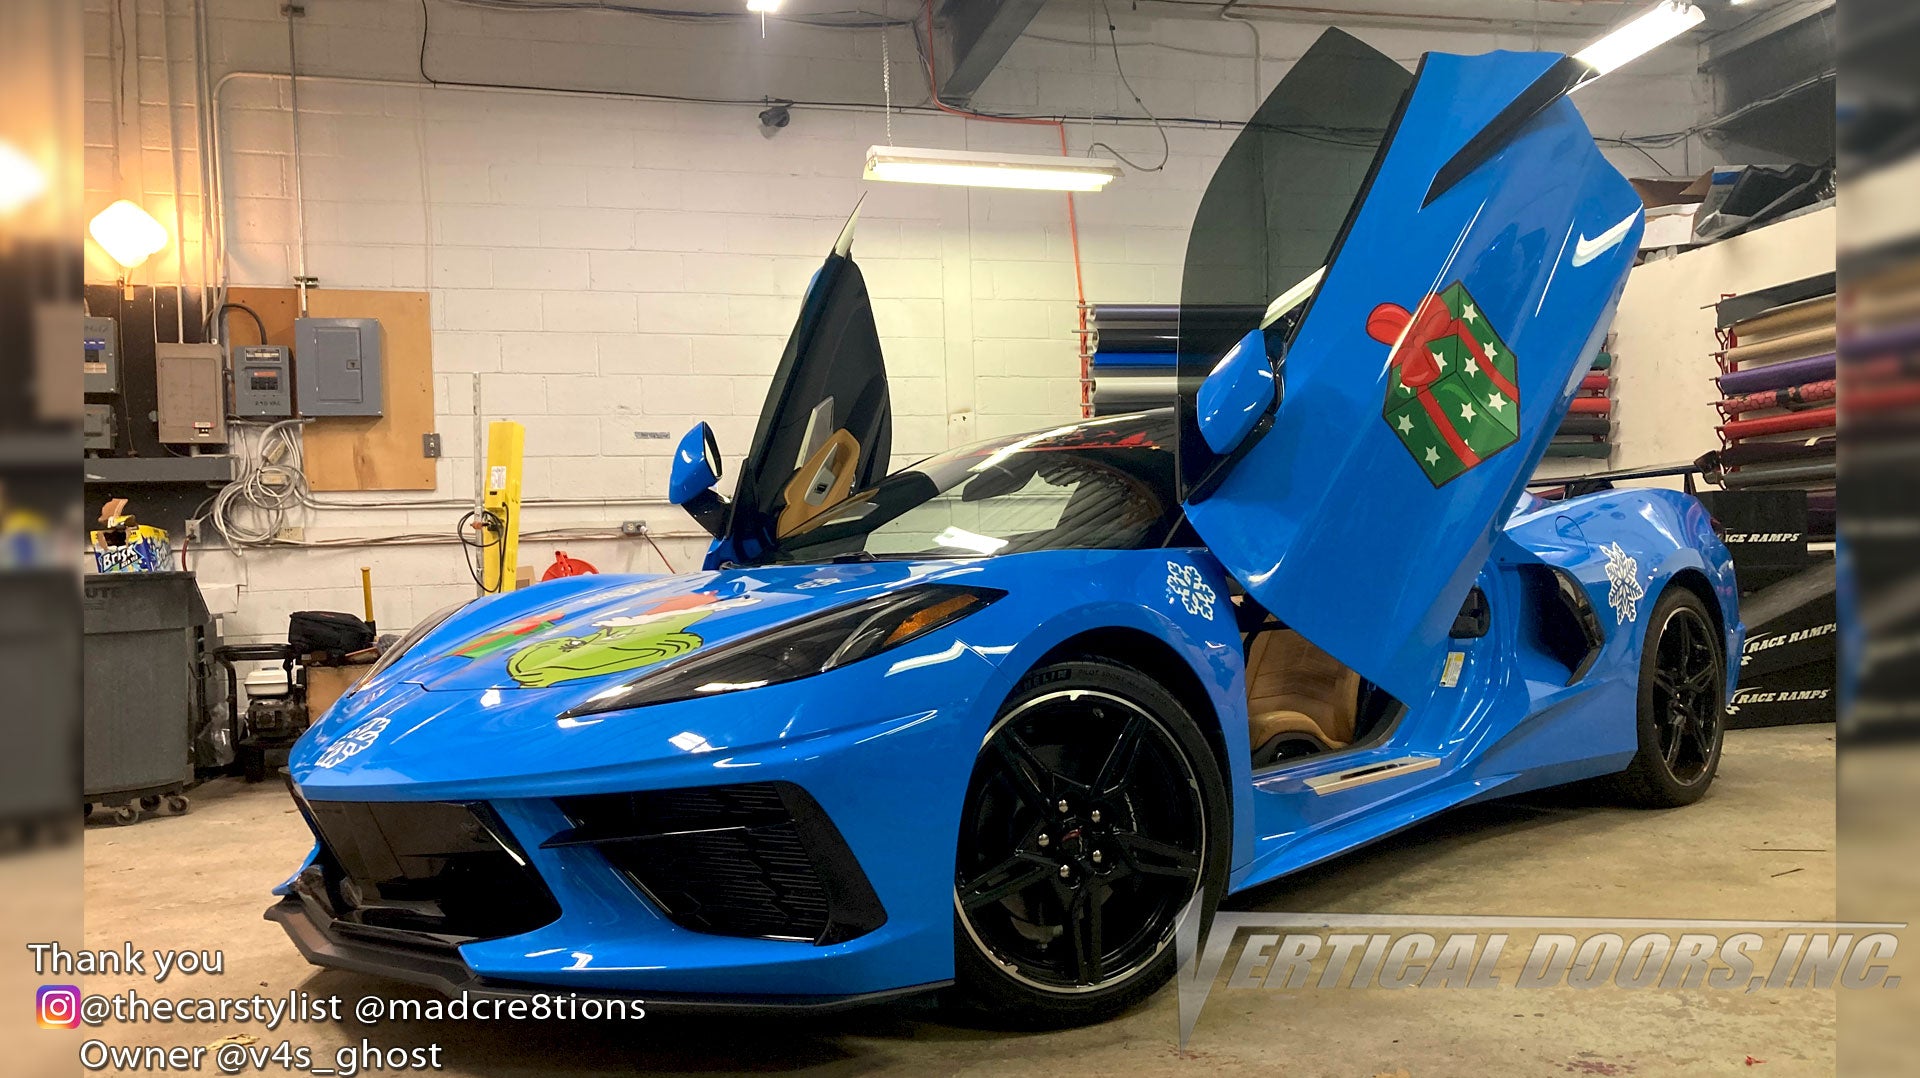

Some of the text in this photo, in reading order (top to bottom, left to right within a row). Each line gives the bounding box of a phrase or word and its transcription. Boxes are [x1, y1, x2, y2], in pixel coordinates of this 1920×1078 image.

[1748, 533, 1800, 543] RAMPS
[103, 544, 136, 571] Brisk
[1748, 622, 1836, 653] RACE RAMPS
[1737, 689, 1830, 704] RACE RAMPS
